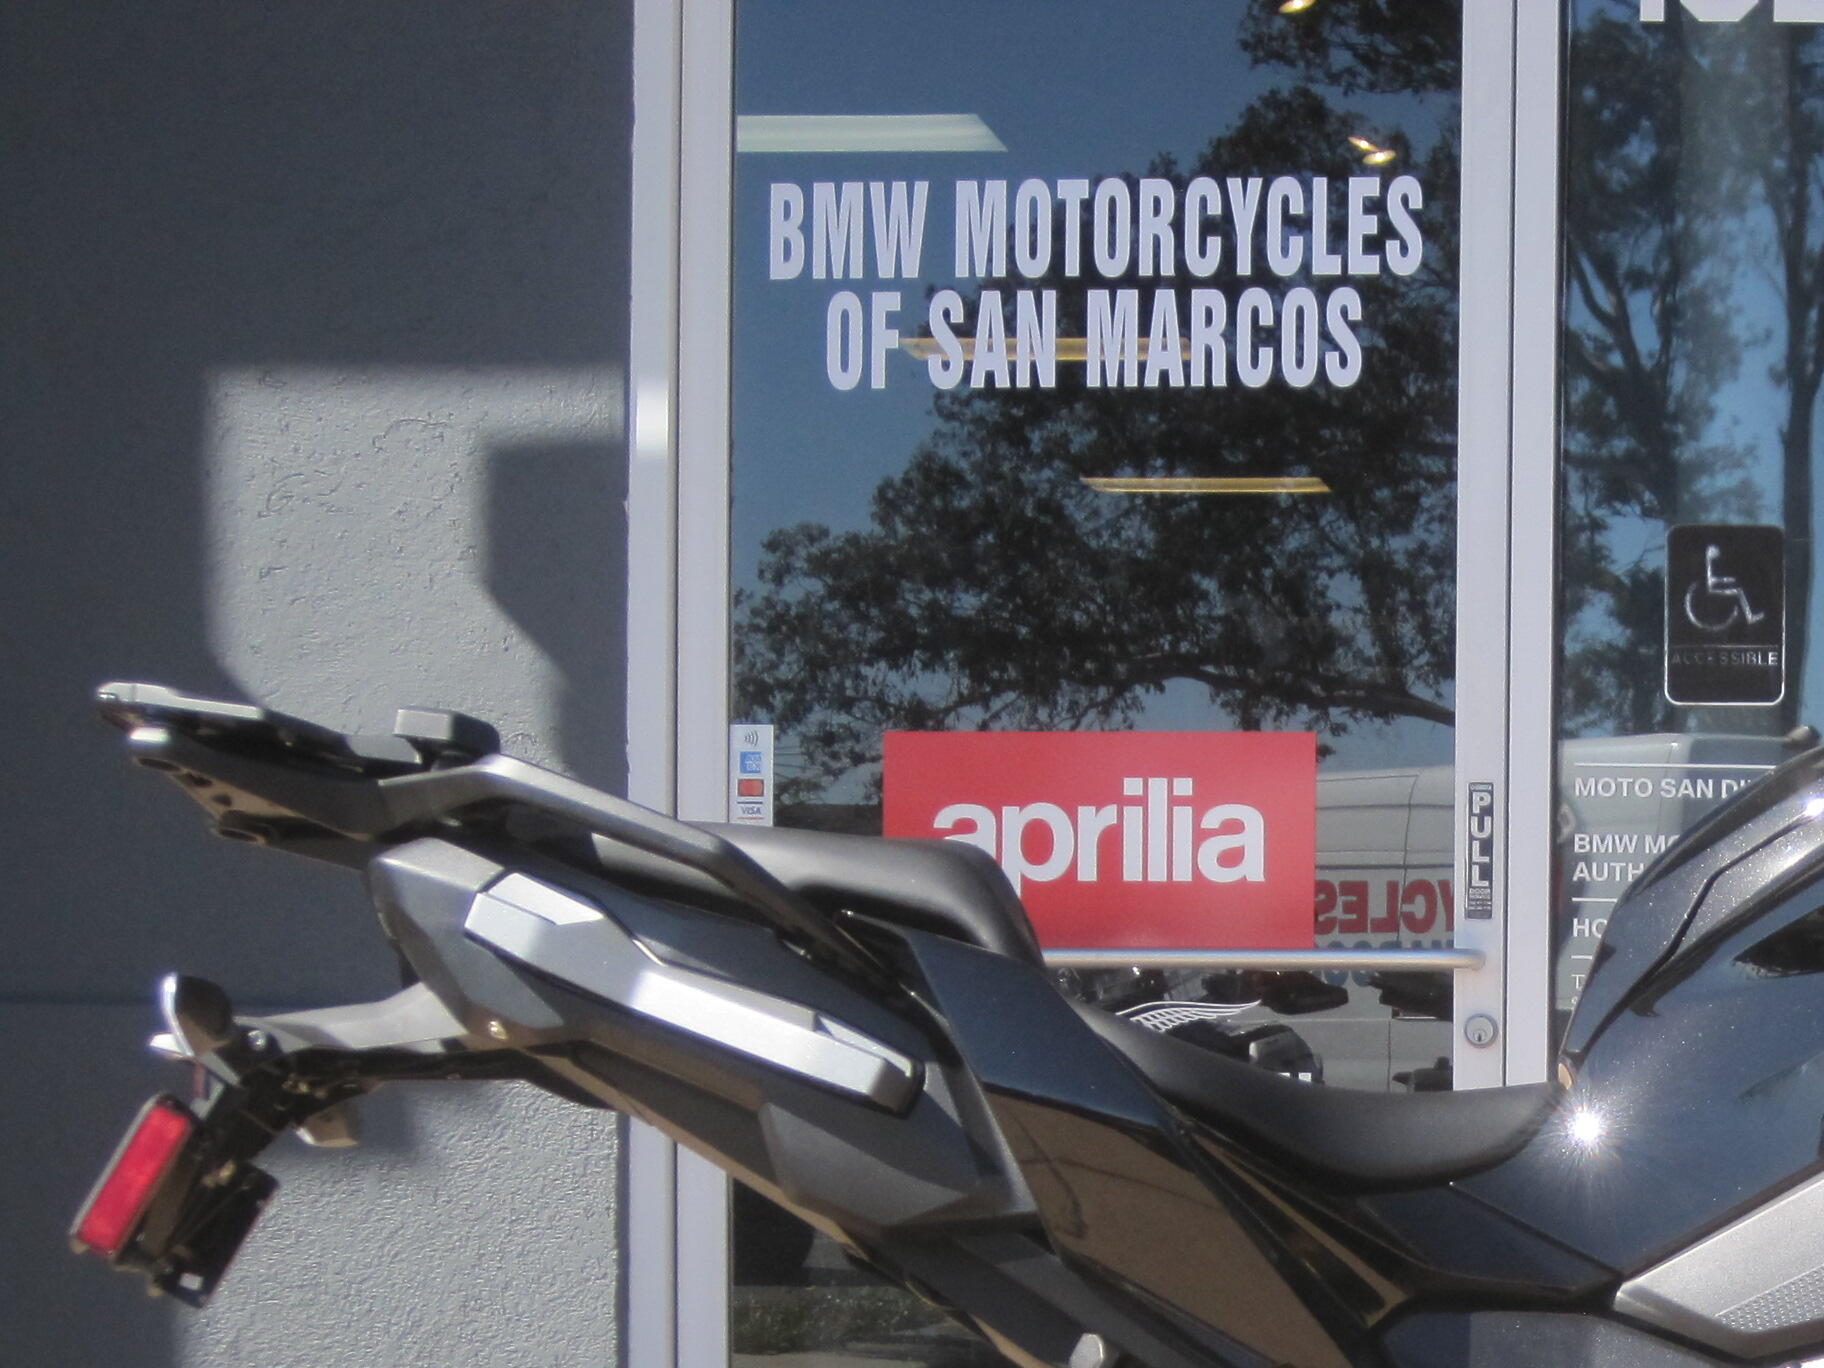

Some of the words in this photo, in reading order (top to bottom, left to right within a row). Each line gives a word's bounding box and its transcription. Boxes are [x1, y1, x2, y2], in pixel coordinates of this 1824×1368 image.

[769, 181, 929, 279] BMW
[955, 176, 1424, 278] MOTORCYCLES
[826, 290, 901, 391] OF
[927, 289, 1057, 390] SAN
[1086, 287, 1363, 389] MARCOS
[1574, 777, 1653, 798] MOTO
[1660, 778, 1713, 798] SAN
[933, 777, 1266, 900] aprilia
[1470, 791, 1492, 887] PULL
[1574, 833, 1638, 853] BMW
